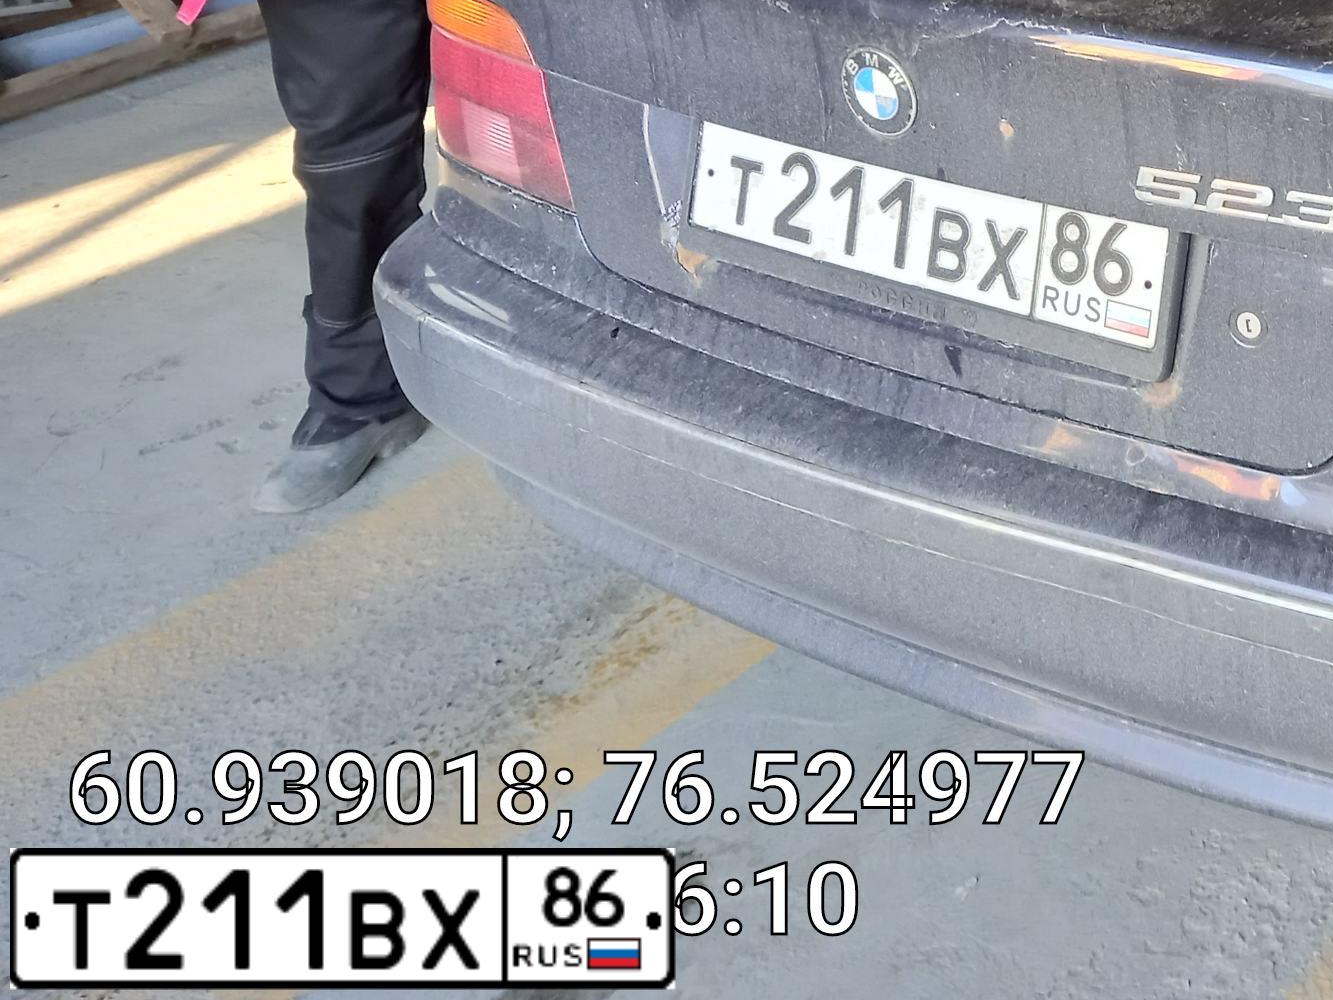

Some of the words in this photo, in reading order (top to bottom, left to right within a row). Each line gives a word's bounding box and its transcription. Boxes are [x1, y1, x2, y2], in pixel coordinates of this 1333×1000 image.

[846, 52, 906, 87] BMW
[1050, 211, 1133, 297] 86
[1042, 285, 1101, 323] RUS
